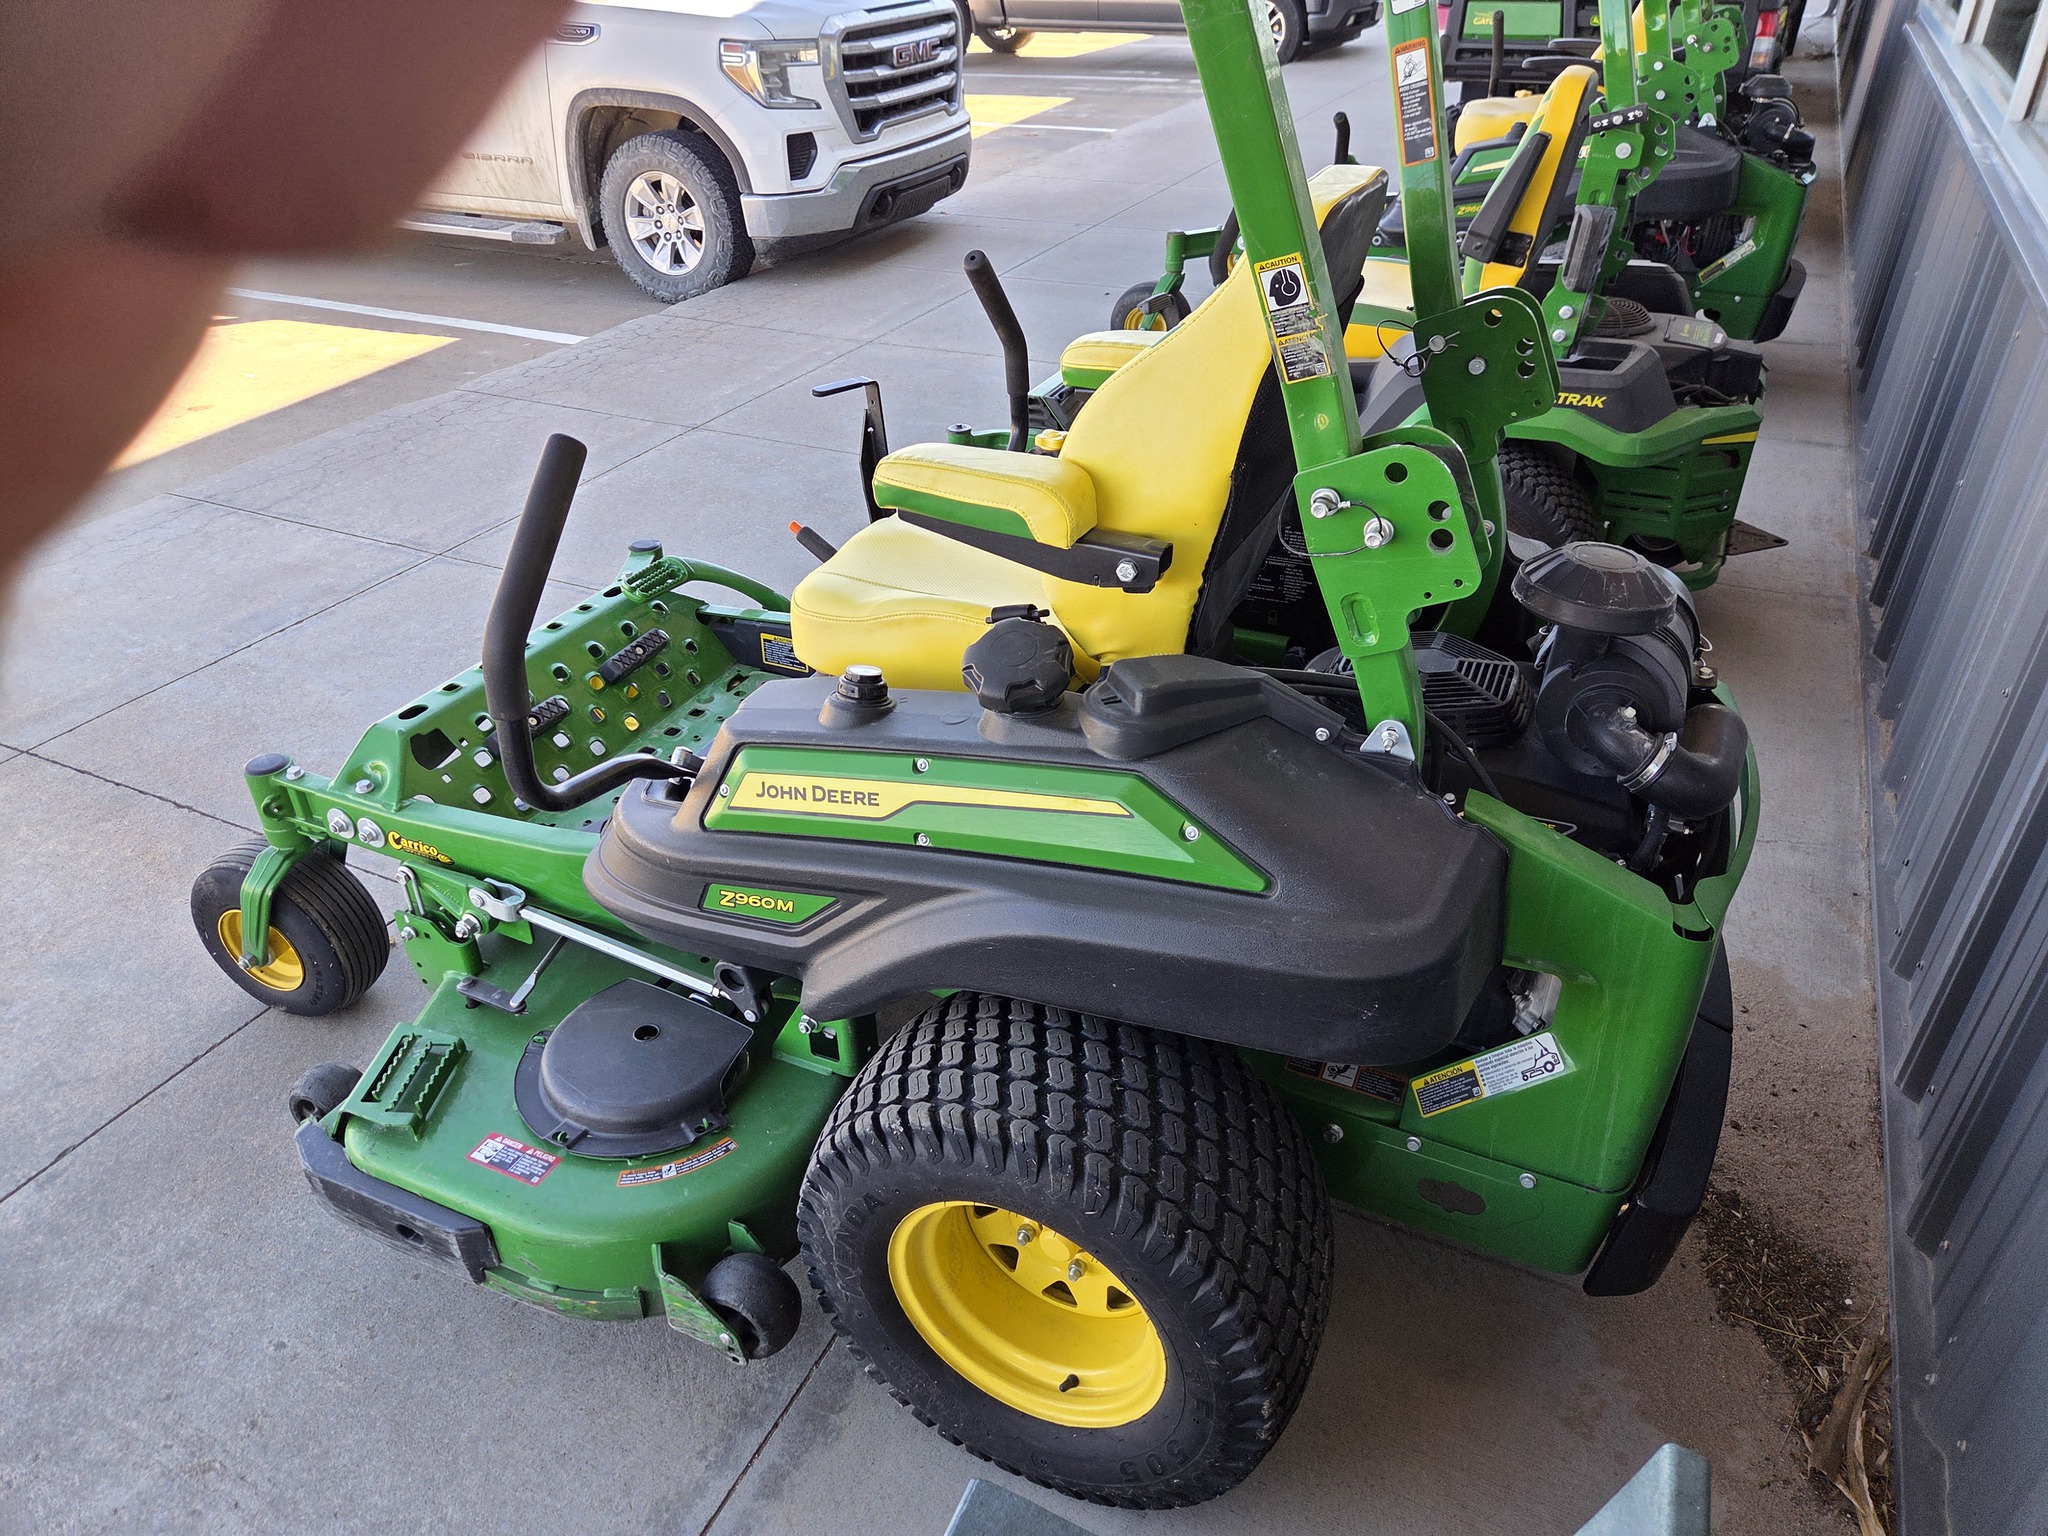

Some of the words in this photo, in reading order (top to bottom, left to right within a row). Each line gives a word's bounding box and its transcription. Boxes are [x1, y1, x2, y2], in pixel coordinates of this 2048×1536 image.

[893, 36, 941, 67] GMC
[1265, 255, 1298, 269] CAUTION
[1554, 391, 1607, 409] TRAK
[756, 781, 807, 802] JOHN
[812, 785, 880, 807] DEERE
[387, 831, 438, 856] Carrico
[719, 889, 794, 913] Z960M
[1429, 1065, 1463, 1084] ATENCIÓN
[502, 1135, 524, 1149] DANGER
[533, 1149, 556, 1163] PELIGRO
